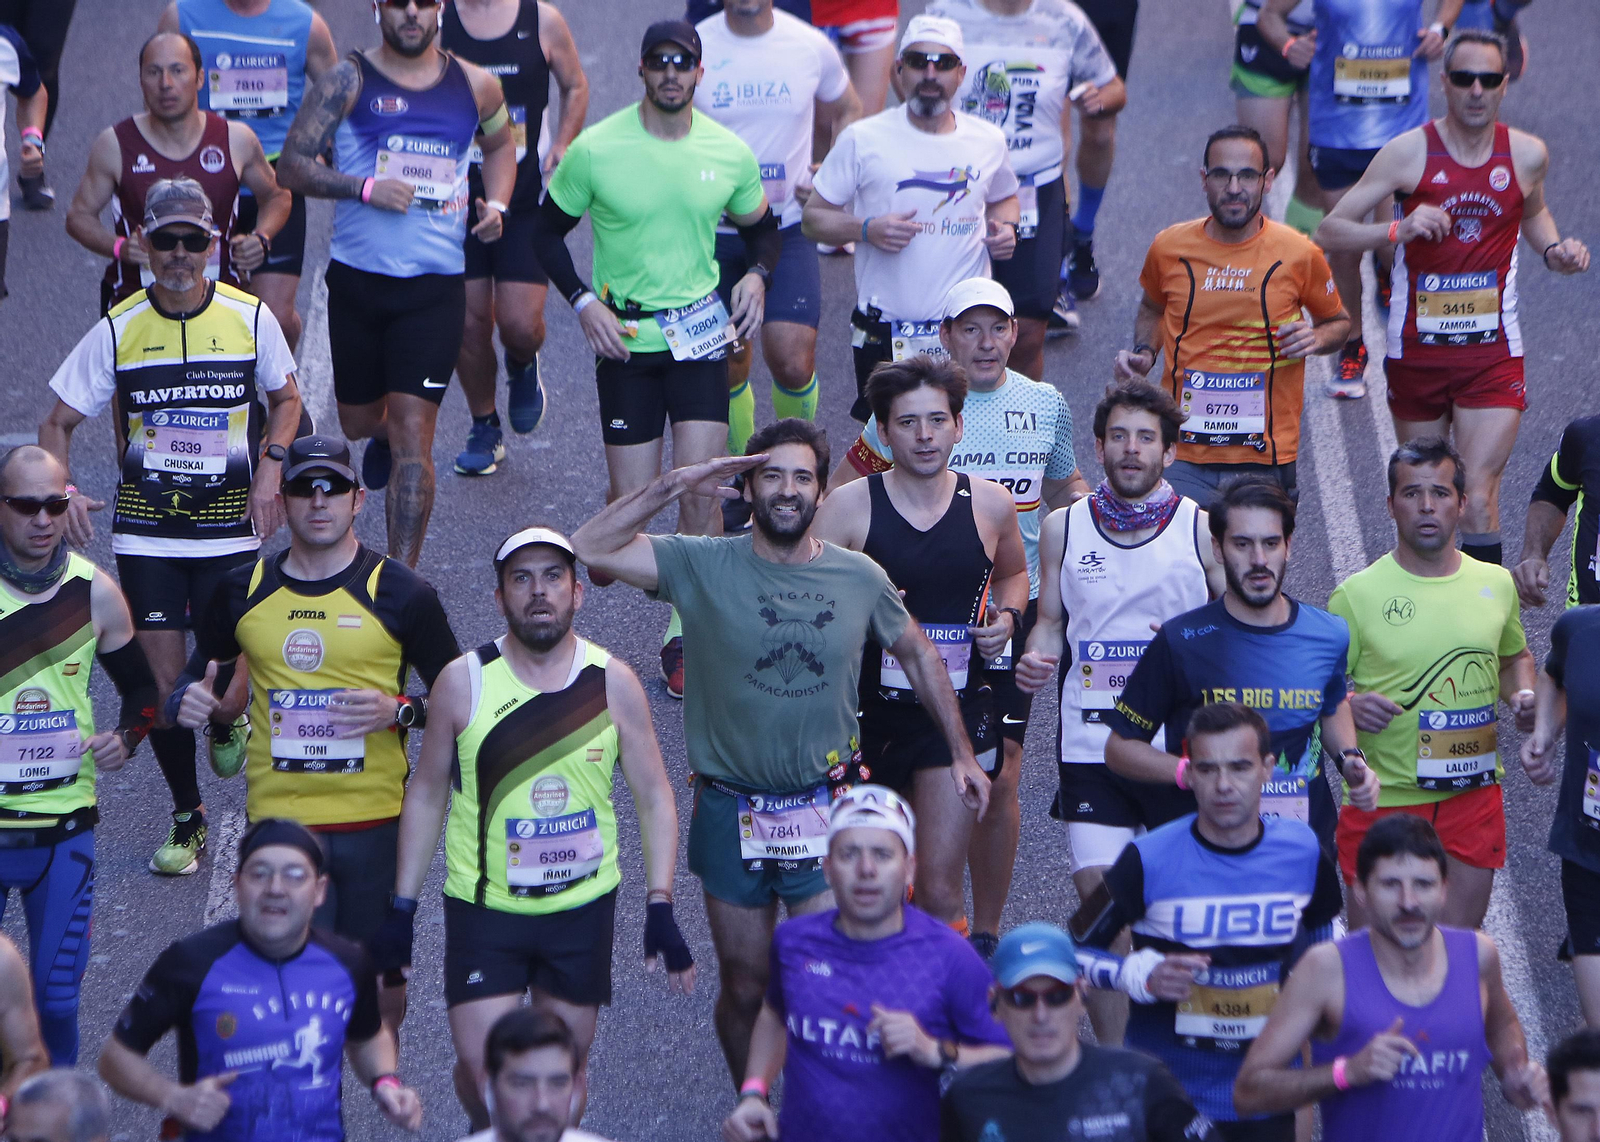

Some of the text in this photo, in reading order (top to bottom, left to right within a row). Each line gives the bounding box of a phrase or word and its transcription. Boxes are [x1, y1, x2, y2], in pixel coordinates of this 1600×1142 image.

[1361, 46, 1404, 57] ZURICH
[234, 56, 278, 67] ZURICH
[1011, 77, 1040, 88] PURA
[737, 82, 791, 98] IBIZA
[232, 97, 262, 105] MIGUEL
[737, 98, 792, 107] MARATHON
[1015, 91, 1037, 132] VIDA
[406, 141, 449, 156] ZURICH
[402, 166, 433, 179] 6988
[1460, 191, 1504, 217] MARATHON
[1207, 263, 1253, 278] sr.door
[1442, 276, 1487, 290] ZURICH
[1443, 303, 1475, 315] 3415
[684, 314, 719, 339] 12804
[1439, 320, 1478, 331] ZAMORA
[186, 369, 244, 381] Club Deportivo
[1207, 377, 1254, 388] ZURICH
[1206, 404, 1239, 415] 6779
[172, 414, 218, 427] ZURICH
[1204, 421, 1238, 431] RAMON
[171, 440, 202, 454] 6339
[164, 458, 204, 470] CHUSKAI
[985, 478, 1032, 495] RO
[757, 591, 836, 609] BRIGADA
[921, 629, 966, 640] URICH
[287, 646, 319, 655] Andarines
[743, 673, 830, 699] PARACAIDISTA
[1108, 675, 1127, 688] 69
[1242, 688, 1273, 709] BIG
[1279, 688, 1322, 710] MECS
[16, 702, 48, 710] Andarines
[18, 717, 67, 731] ZURICH
[1451, 710, 1491, 726] ZURICH
[298, 725, 335, 738] 6365
[18, 746, 55, 760] 7122
[303, 745, 327, 756] TONI
[1449, 741, 1480, 756] 4855
[19, 766, 50, 778] LONGI
[533, 791, 566, 800] Andarines
[539, 816, 588, 835] ZURICH
[768, 824, 801, 839] 7841
[539, 849, 576, 864] 6399
[766, 844, 809, 857] PIPANDA
[543, 868, 571, 880] IÑAKI
[1213, 970, 1268, 986] ZURICH
[1212, 1001, 1250, 1017] 4384
[1212, 1023, 1246, 1035] SANTI
[223, 1041, 290, 1068] RUNNING
